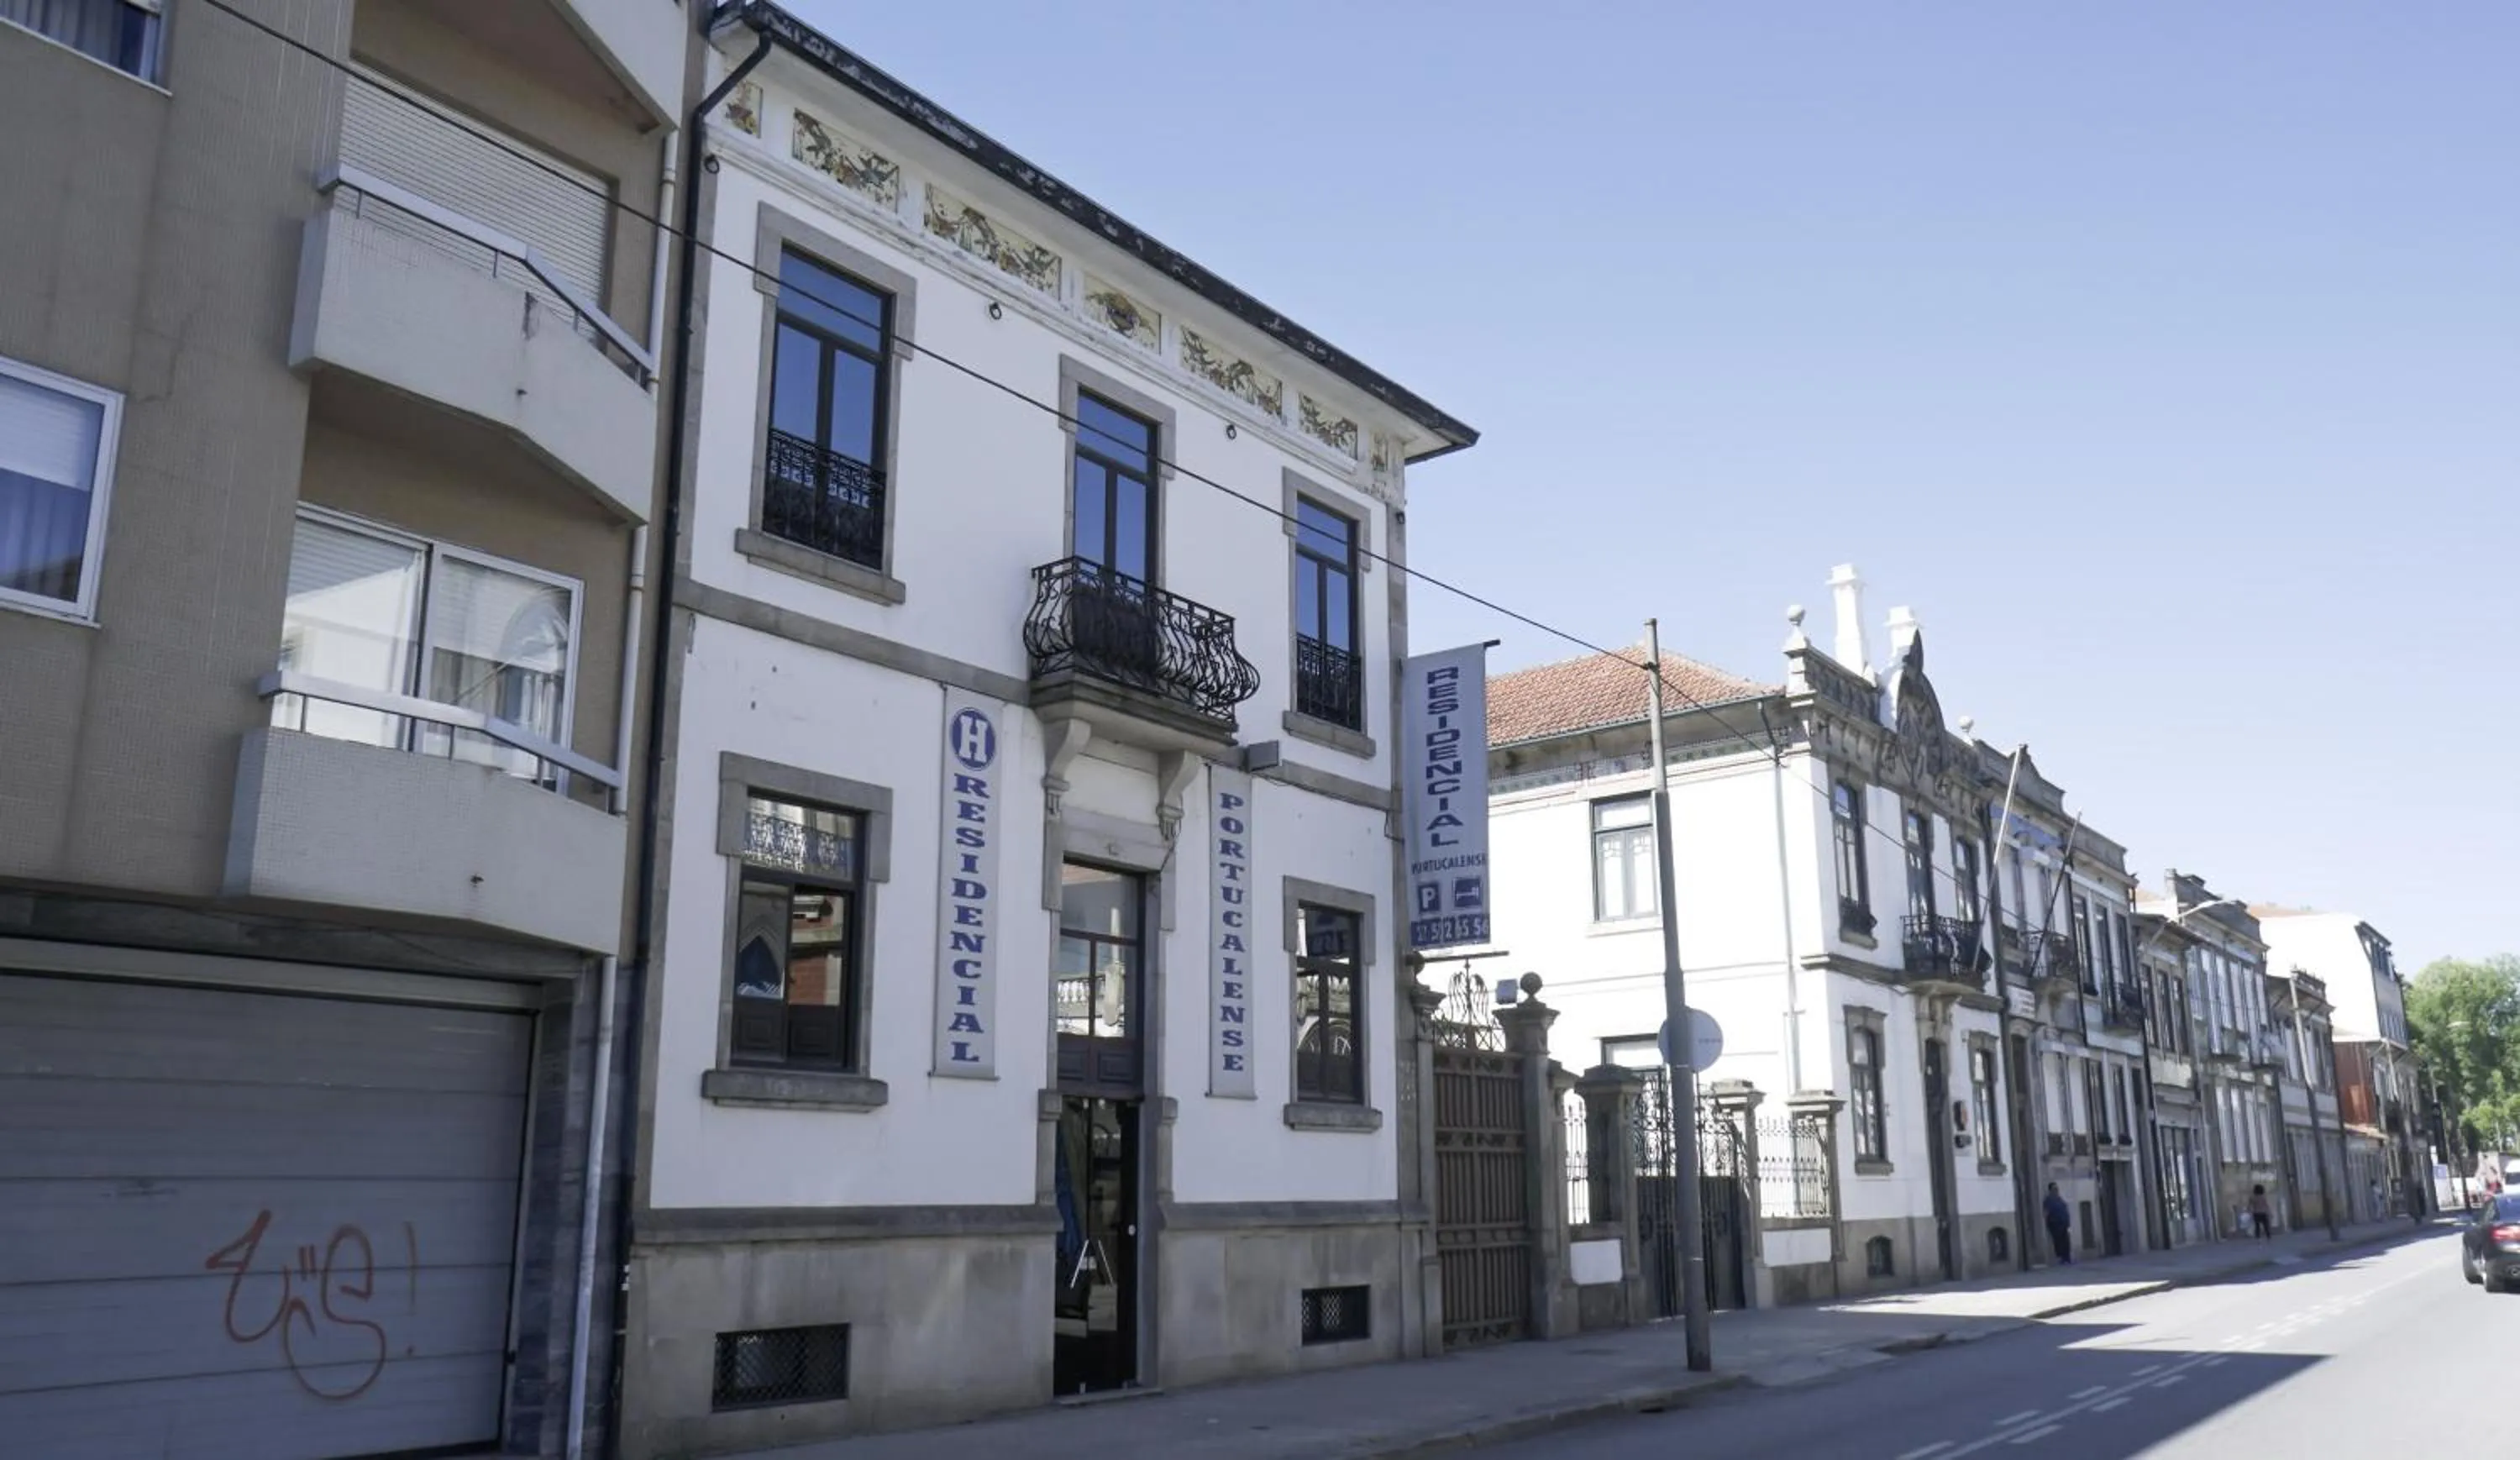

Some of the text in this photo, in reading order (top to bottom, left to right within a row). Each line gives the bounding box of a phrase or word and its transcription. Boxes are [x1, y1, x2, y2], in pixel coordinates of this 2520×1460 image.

[1425, 666, 1464, 848] RESIDENCIAL
[948, 772, 990, 1063] RESIDENCIAL
[1219, 791, 1246, 1072] PORTUCALENSE
